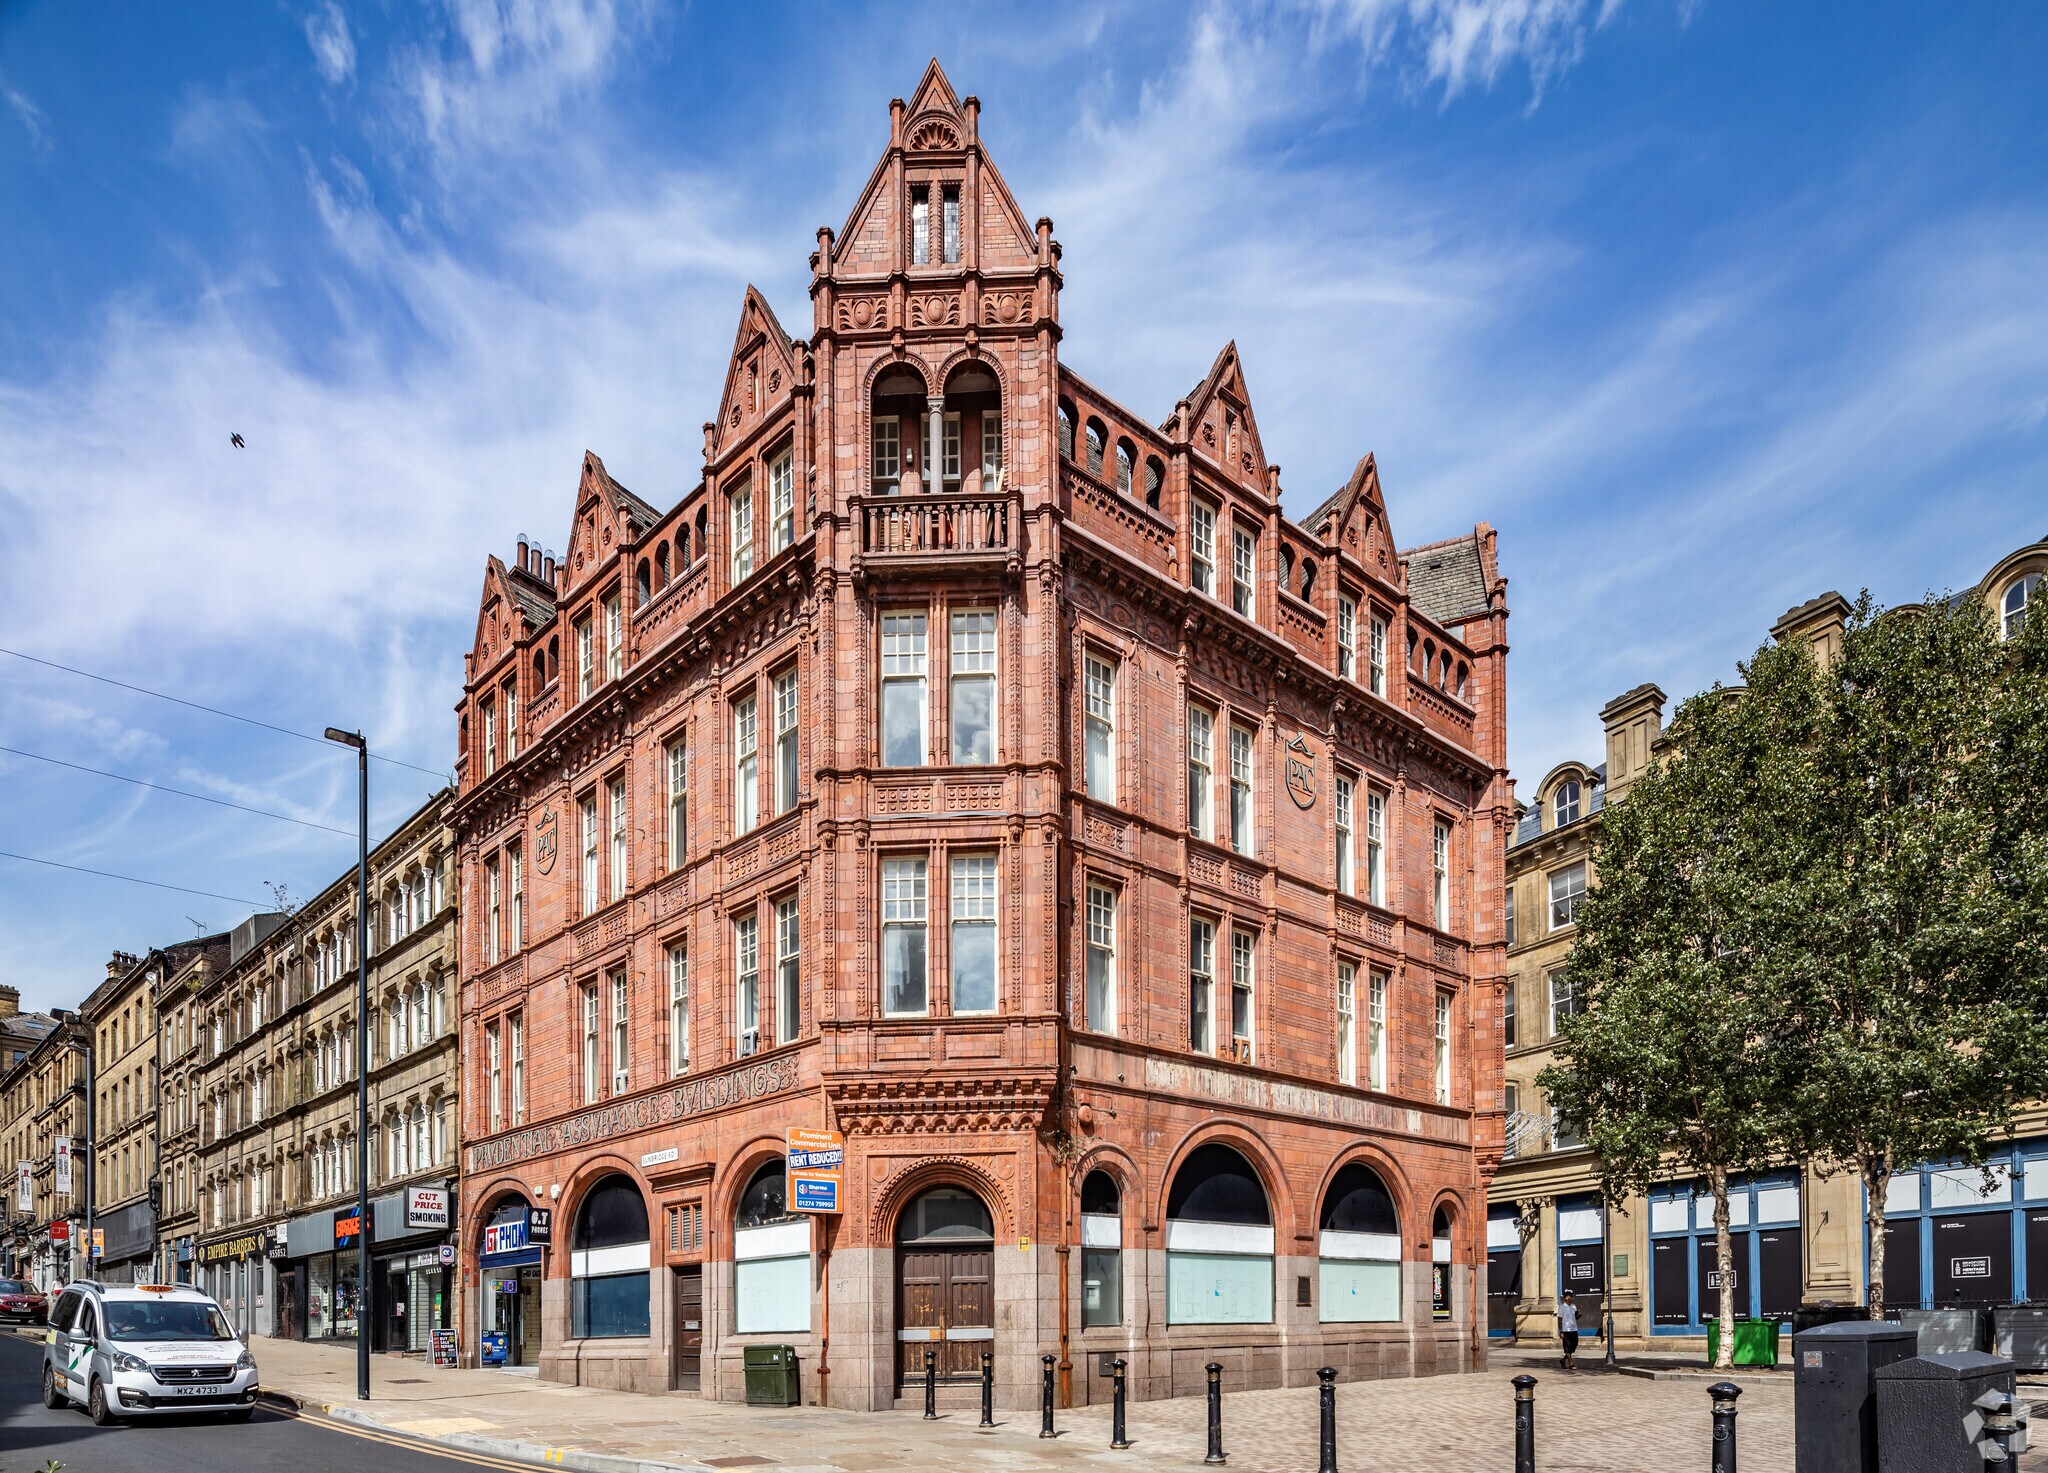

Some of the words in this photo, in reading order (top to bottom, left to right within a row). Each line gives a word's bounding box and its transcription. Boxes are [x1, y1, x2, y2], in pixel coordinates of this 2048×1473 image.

[800, 1131, 832, 1140] Prominent
[790, 1139, 827, 1148] Commercial
[642, 1151, 667, 1165] SUNBRIDGE
[790, 1154, 807, 1168] RENT
[418, 1193, 439, 1201] CUT
[414, 1201, 443, 1210] PRICE
[410, 1212, 446, 1223] SMOKING
[531, 1226, 549, 1234] PHONES
[487, 1228, 498, 1252] GT
[500, 1222, 525, 1250] PHON
[207, 1241, 229, 1260] EMPIRE
[229, 1236, 256, 1256] BARBERS
